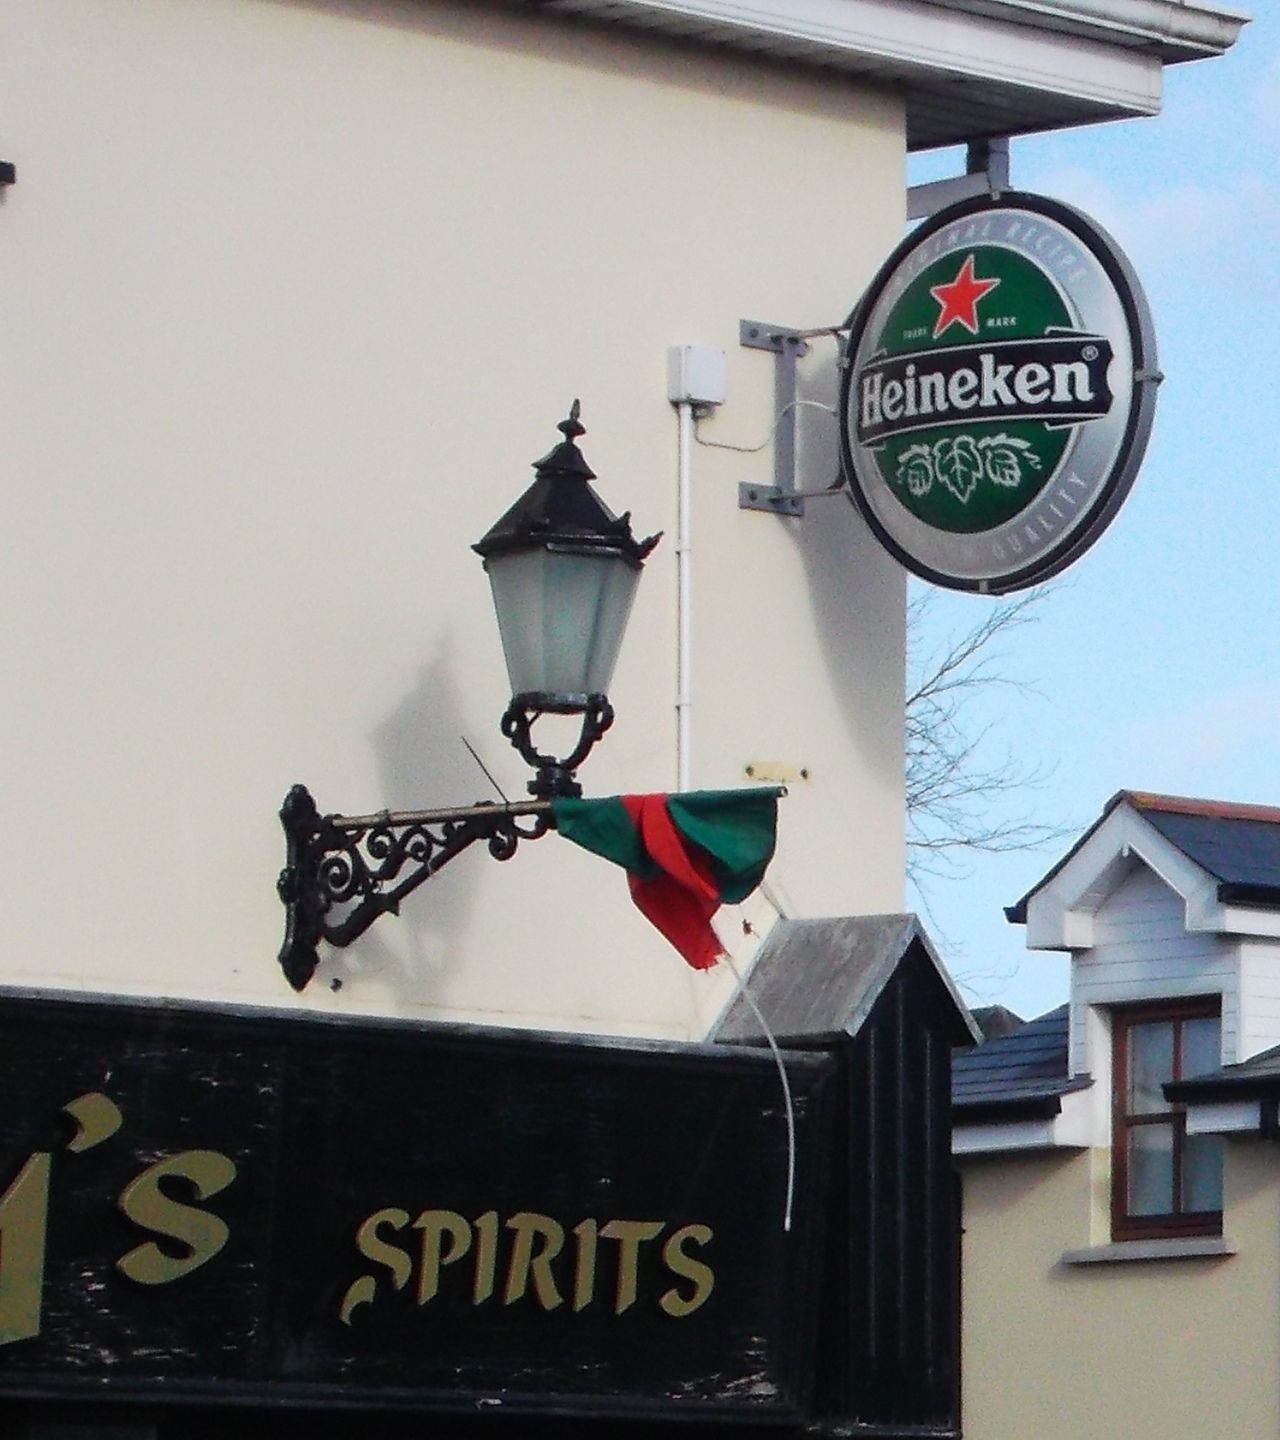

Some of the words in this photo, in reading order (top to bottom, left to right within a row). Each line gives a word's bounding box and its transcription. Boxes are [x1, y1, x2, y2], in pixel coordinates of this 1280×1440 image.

[985, 316, 1018, 328] MARK
[861, 353, 1096, 428] Heineken
[340, 1208, 715, 1326] SPIRITS
